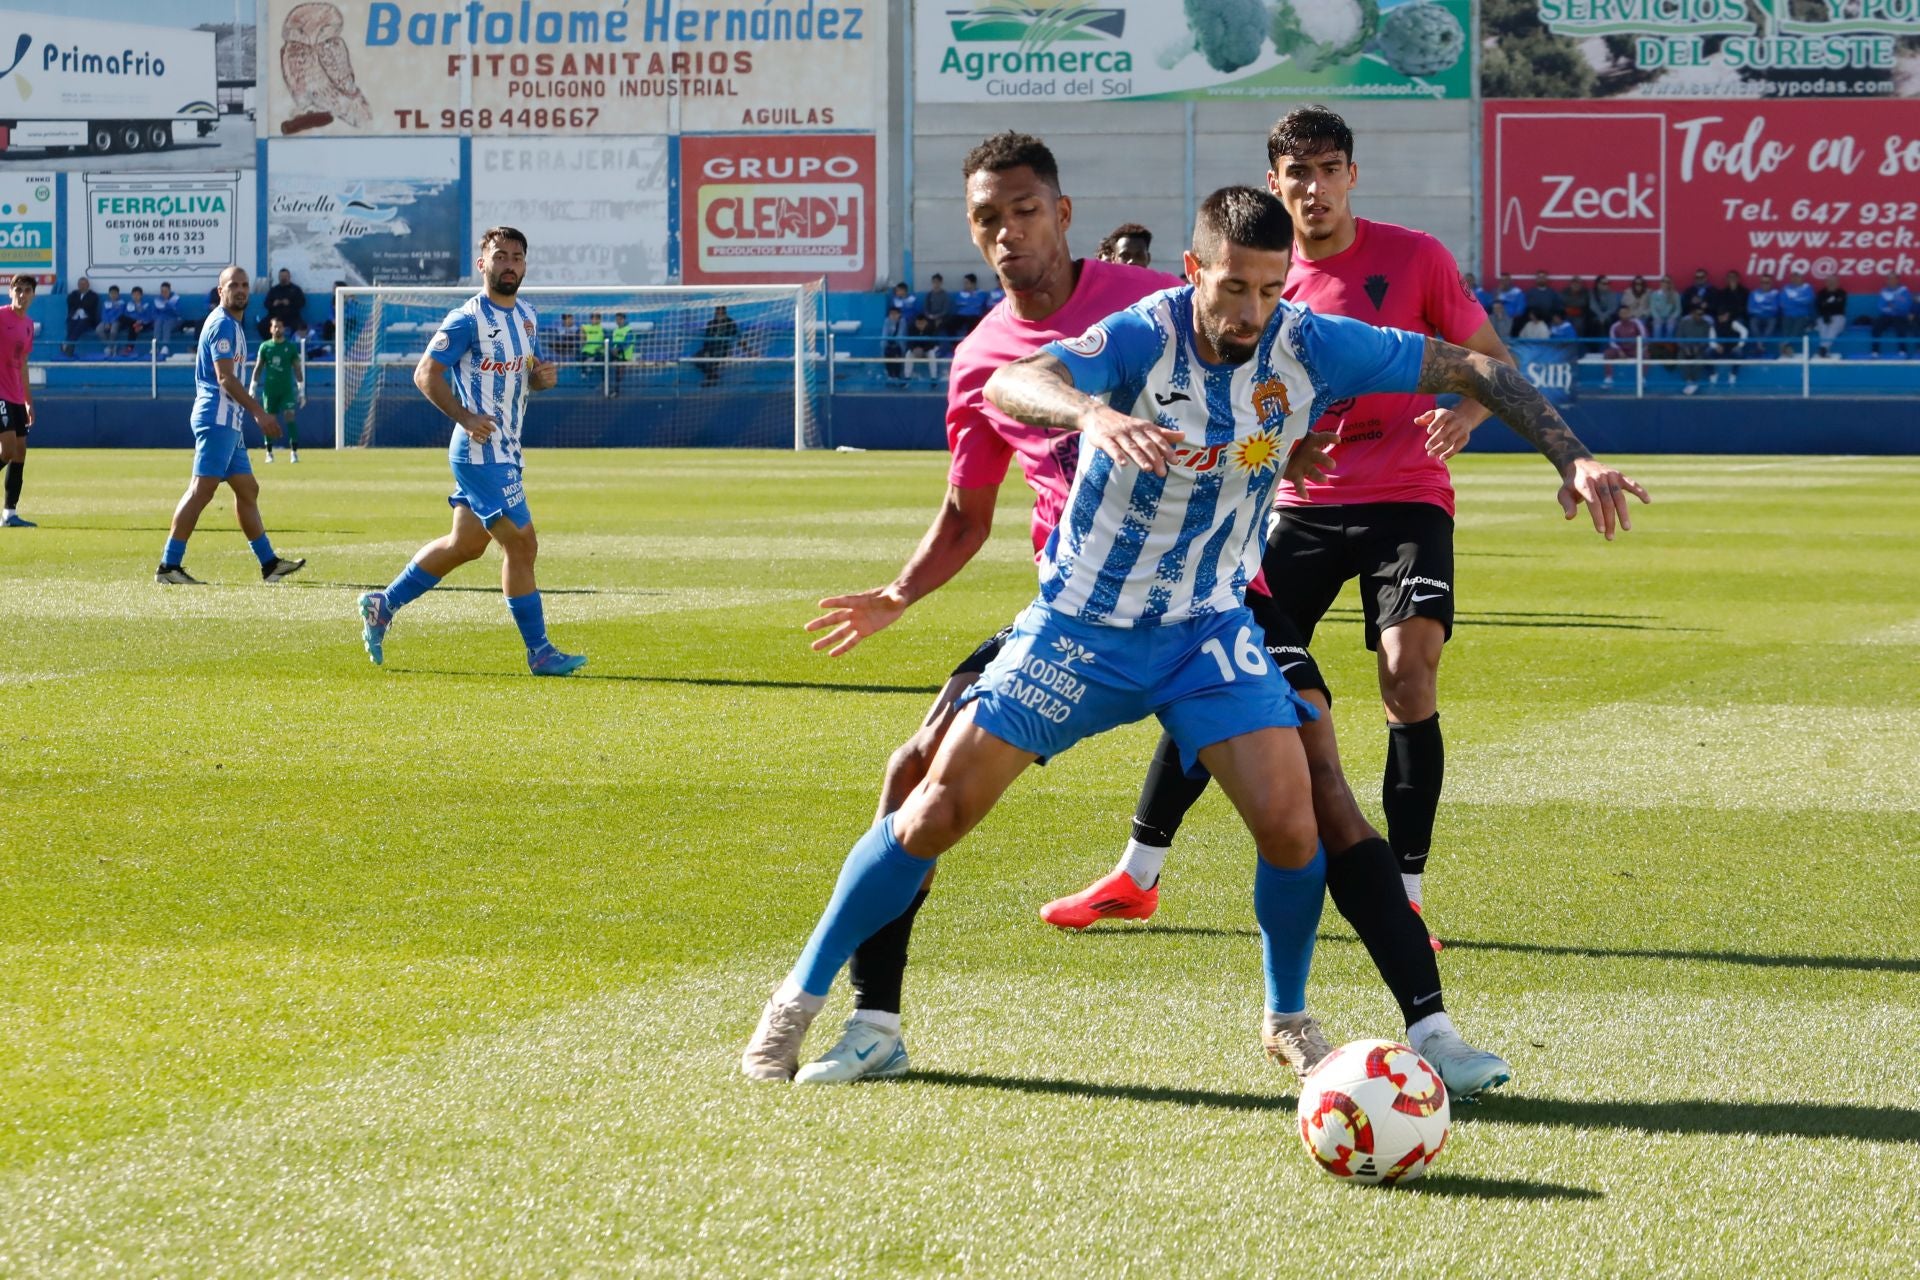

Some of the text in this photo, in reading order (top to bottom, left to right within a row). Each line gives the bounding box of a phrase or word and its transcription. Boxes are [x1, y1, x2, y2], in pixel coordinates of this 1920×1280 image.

[1540, 0, 1747, 21] SERVICIOS
[365, 0, 864, 46] Bartolomé Hernández
[1639, 38, 1894, 67] DEL SURESTE
[447, 52, 753, 76] FITOSANITARIOS
[940, 46, 1133, 81] Agromerca
[508, 79, 738, 98] POLIGONO INDUSTRIAL
[986, 78, 1133, 96] Ciudad del Sol
[394, 110, 429, 129] TL
[741, 108, 835, 125] AGUILAS
[1672, 115, 1796, 183] Todo
[1808, 135, 1866, 175] en
[703, 156, 859, 179] GRUPO
[272, 195, 336, 213] Estrella
[1539, 172, 1655, 218] Zeck
[97, 196, 226, 216] FERROLIVA
[1723, 198, 1918, 224] Tel. 647 932
[153, 219, 166, 228] DE
[168, 218, 219, 228] RESIDUOS
[133, 231, 205, 242] 968 410 323
[133, 245, 205, 256] 679 475 313
[713, 245, 843, 255] PRODUCTOS ARTESANOS
[1201, 625, 1268, 682] 16
